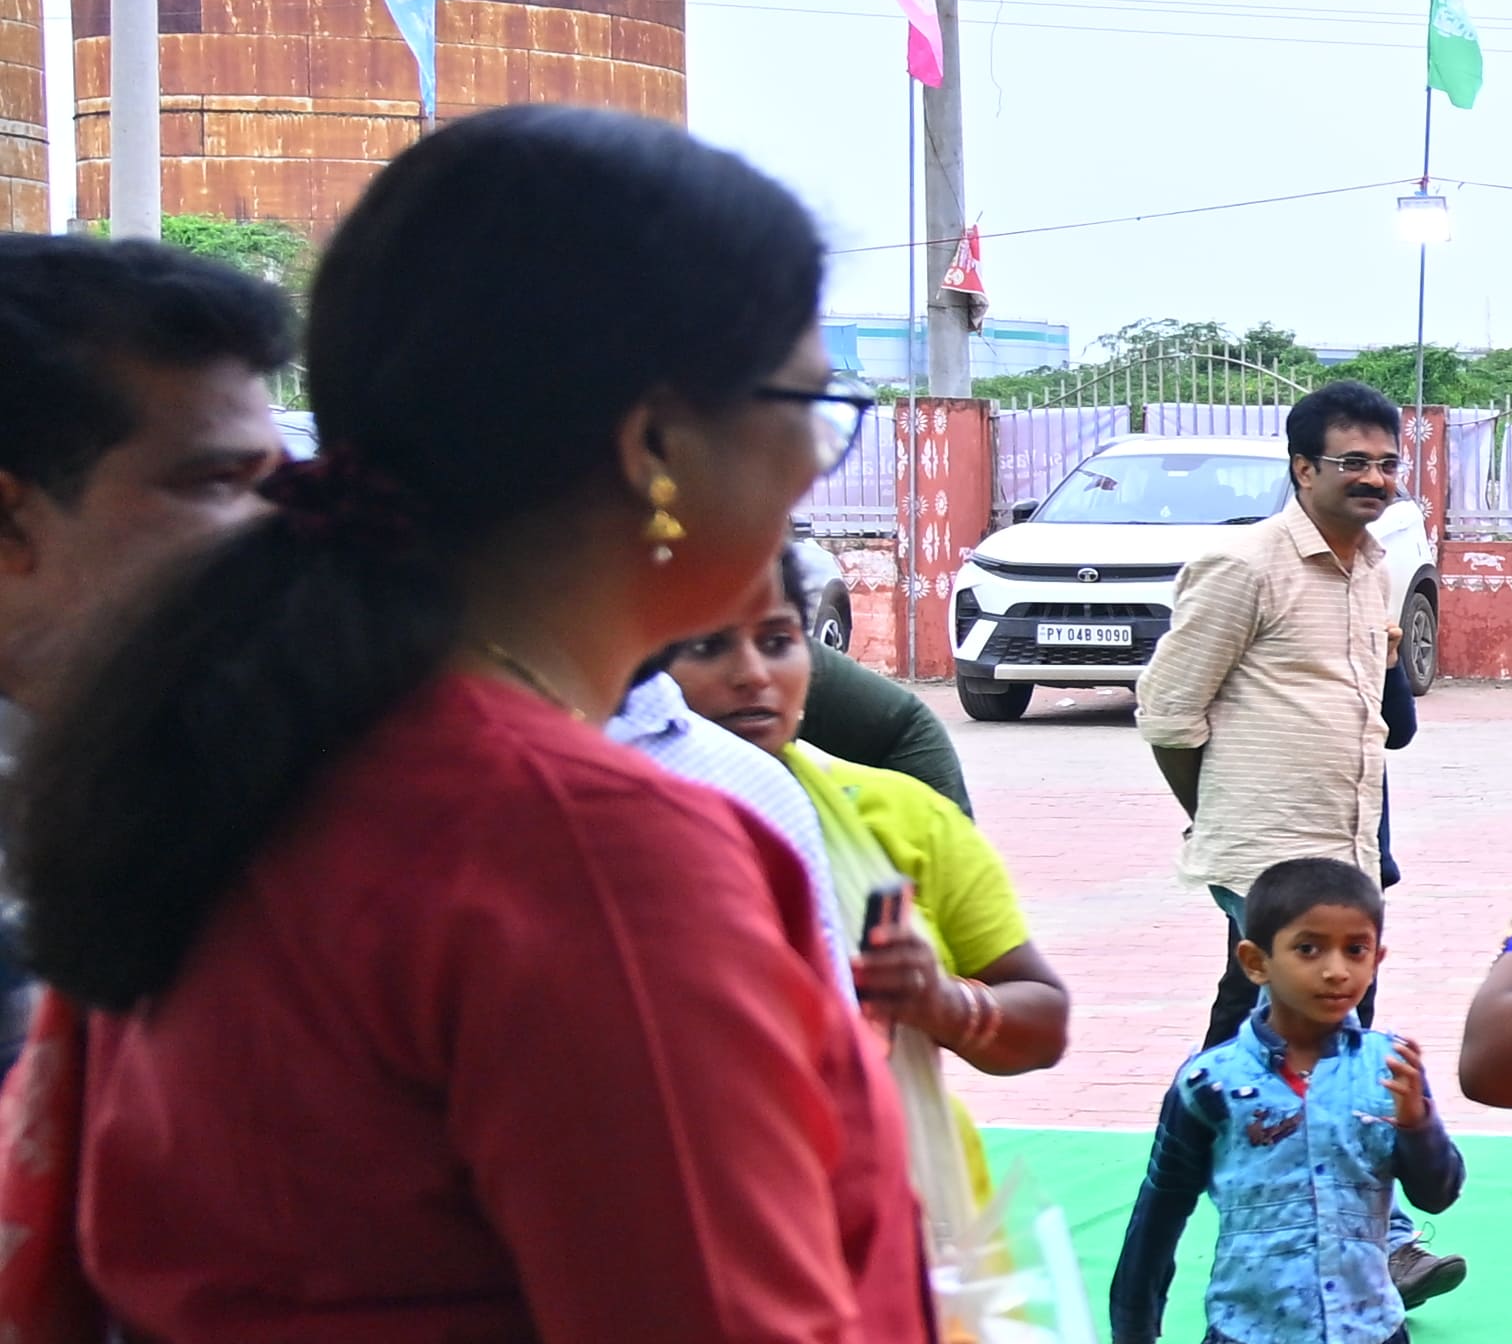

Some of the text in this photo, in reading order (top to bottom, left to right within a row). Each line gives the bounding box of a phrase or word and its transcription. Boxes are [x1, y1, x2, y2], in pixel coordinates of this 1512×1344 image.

[1047, 627, 1129, 642] PY 04B 9090
